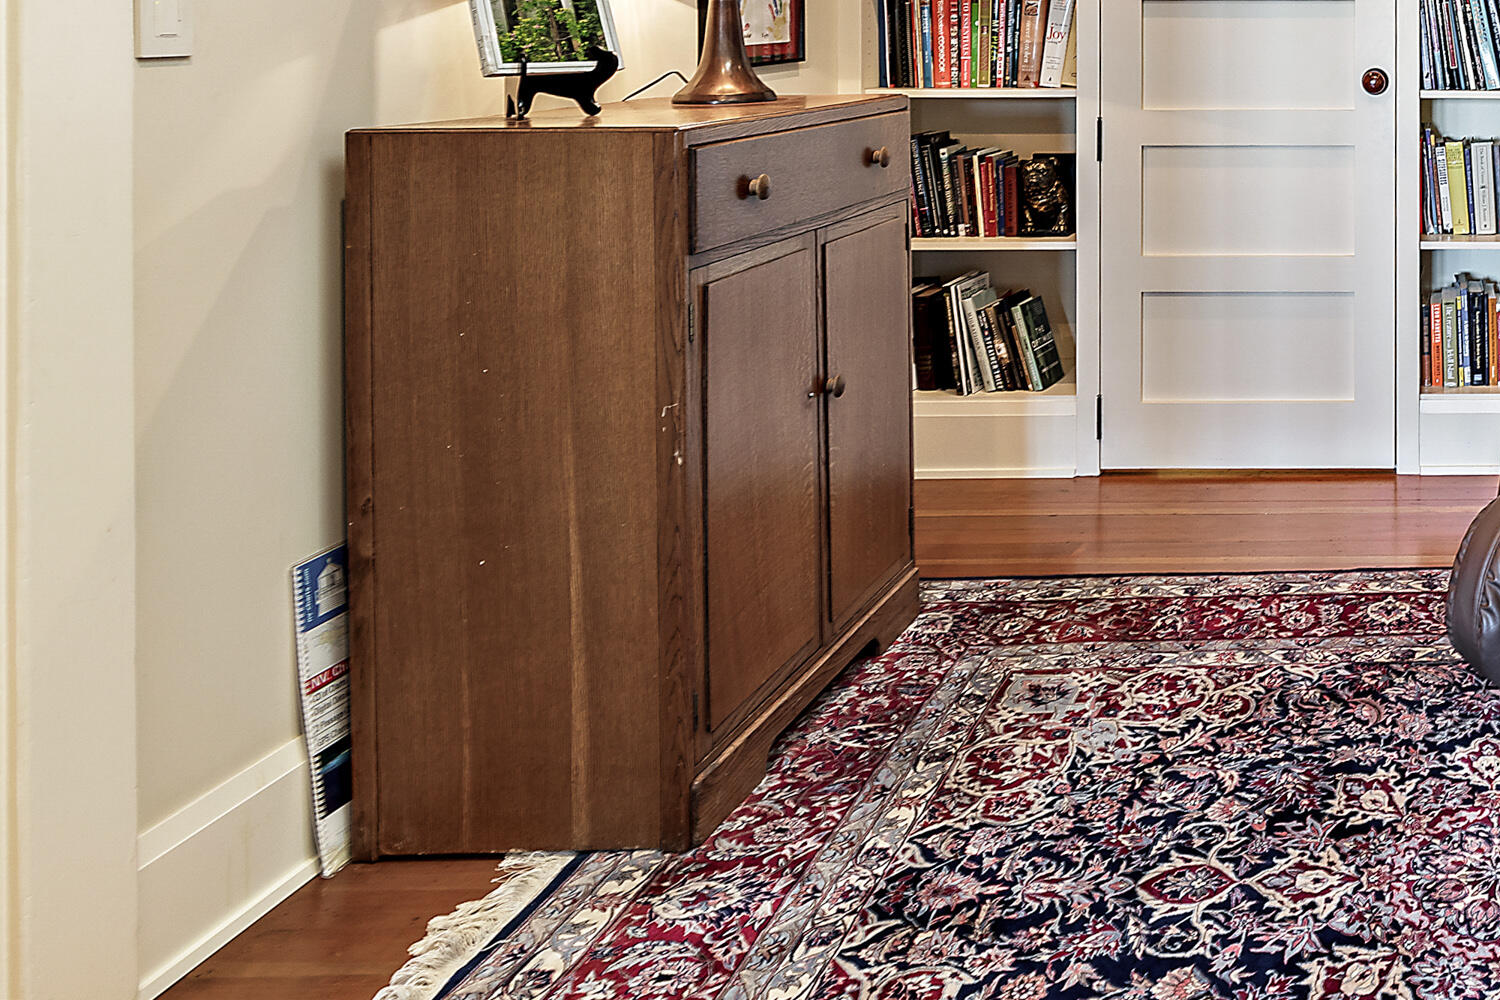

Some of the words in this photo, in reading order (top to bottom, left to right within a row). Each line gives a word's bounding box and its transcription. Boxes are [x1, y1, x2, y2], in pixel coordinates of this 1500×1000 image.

[992, 19, 999, 33] MY
[990, 35, 998, 62] PIZZA
[967, 312, 981, 352] MIGRATIONS
[1034, 324, 1045, 333] THE
[993, 371, 1004, 389] THIEF
